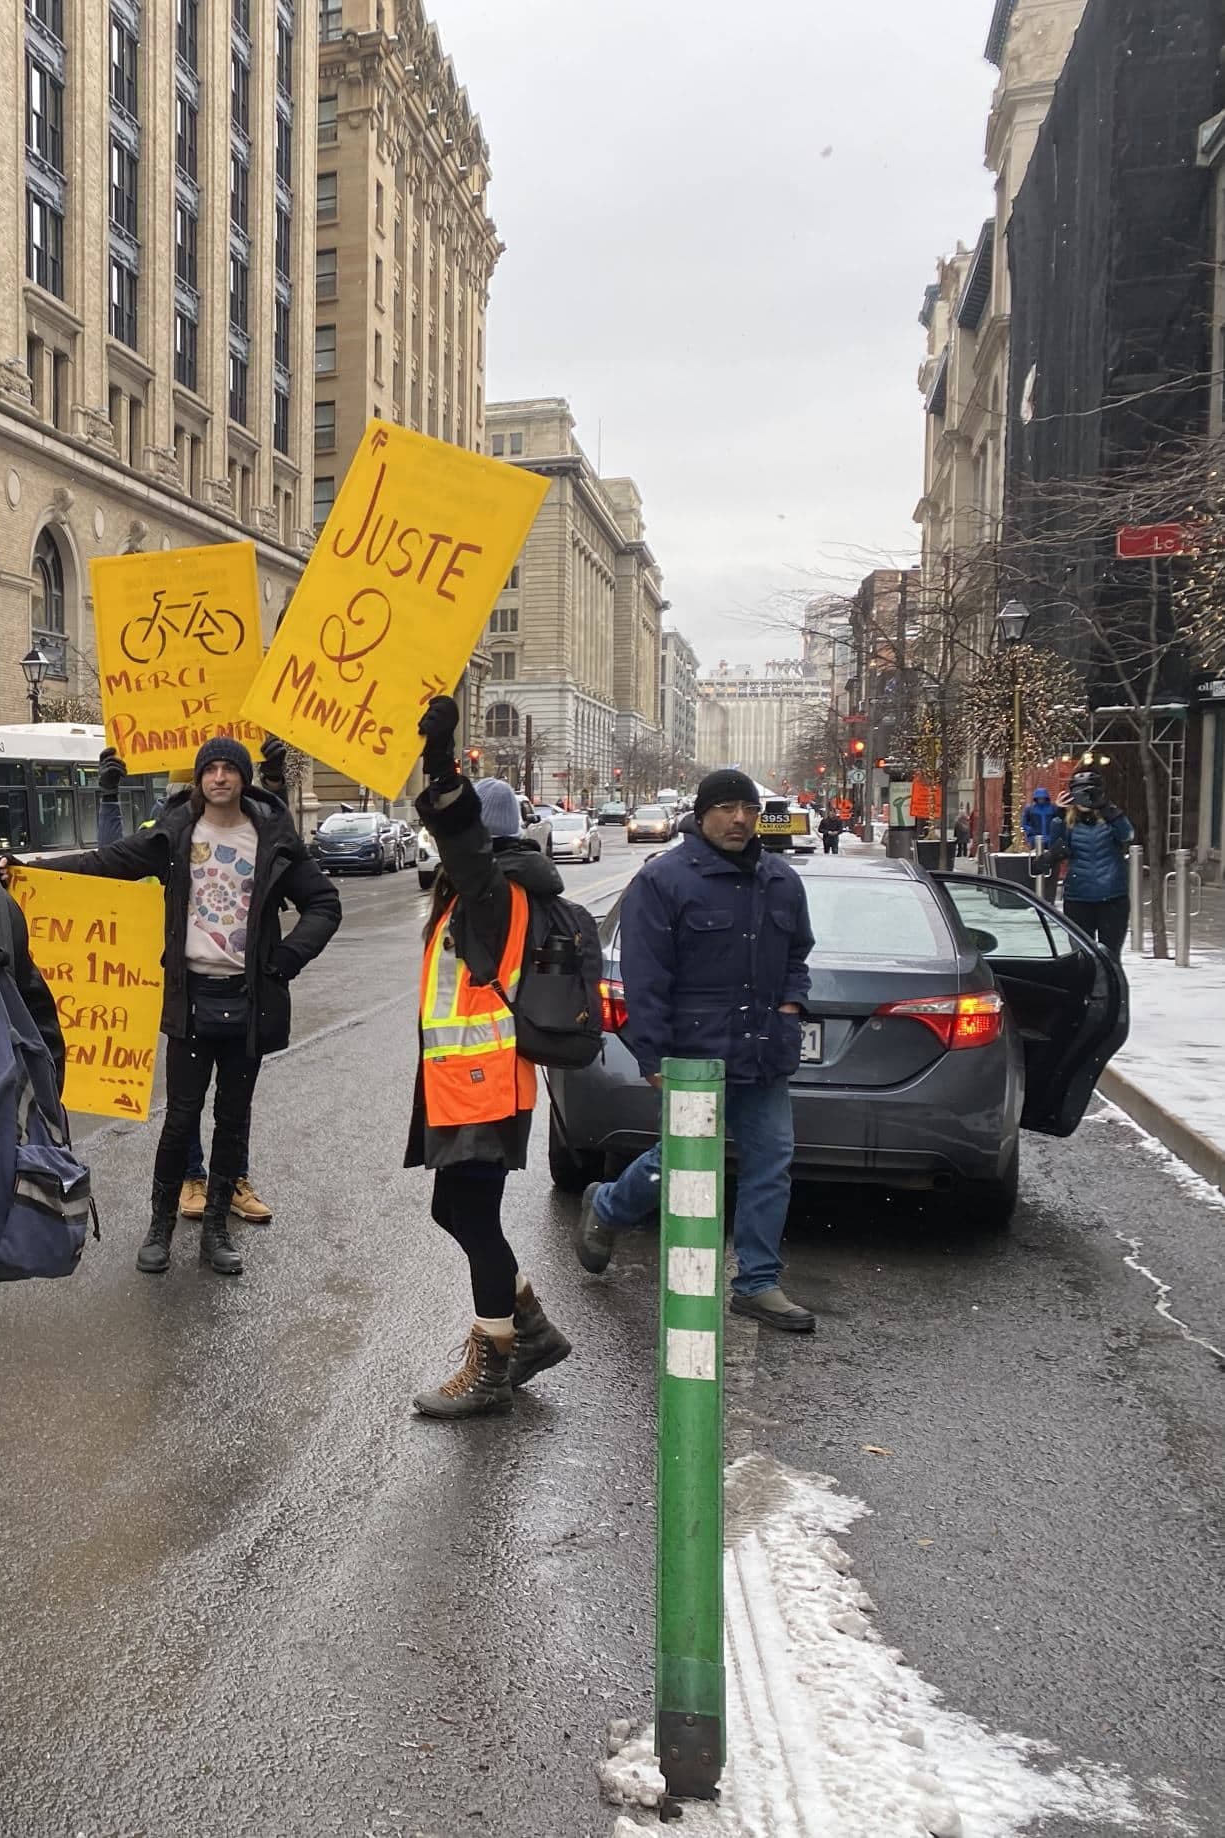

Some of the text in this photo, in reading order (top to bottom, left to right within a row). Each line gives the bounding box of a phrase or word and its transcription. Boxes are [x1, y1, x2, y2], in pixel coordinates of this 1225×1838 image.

[332, 463, 483, 602] JUSTE
[320, 588, 392, 683] 2
[106, 667, 205, 696] MERCI
[181, 692, 224, 719] DE
[761, 814, 790, 823] 3953
[56, 995, 128, 1032] SERA
